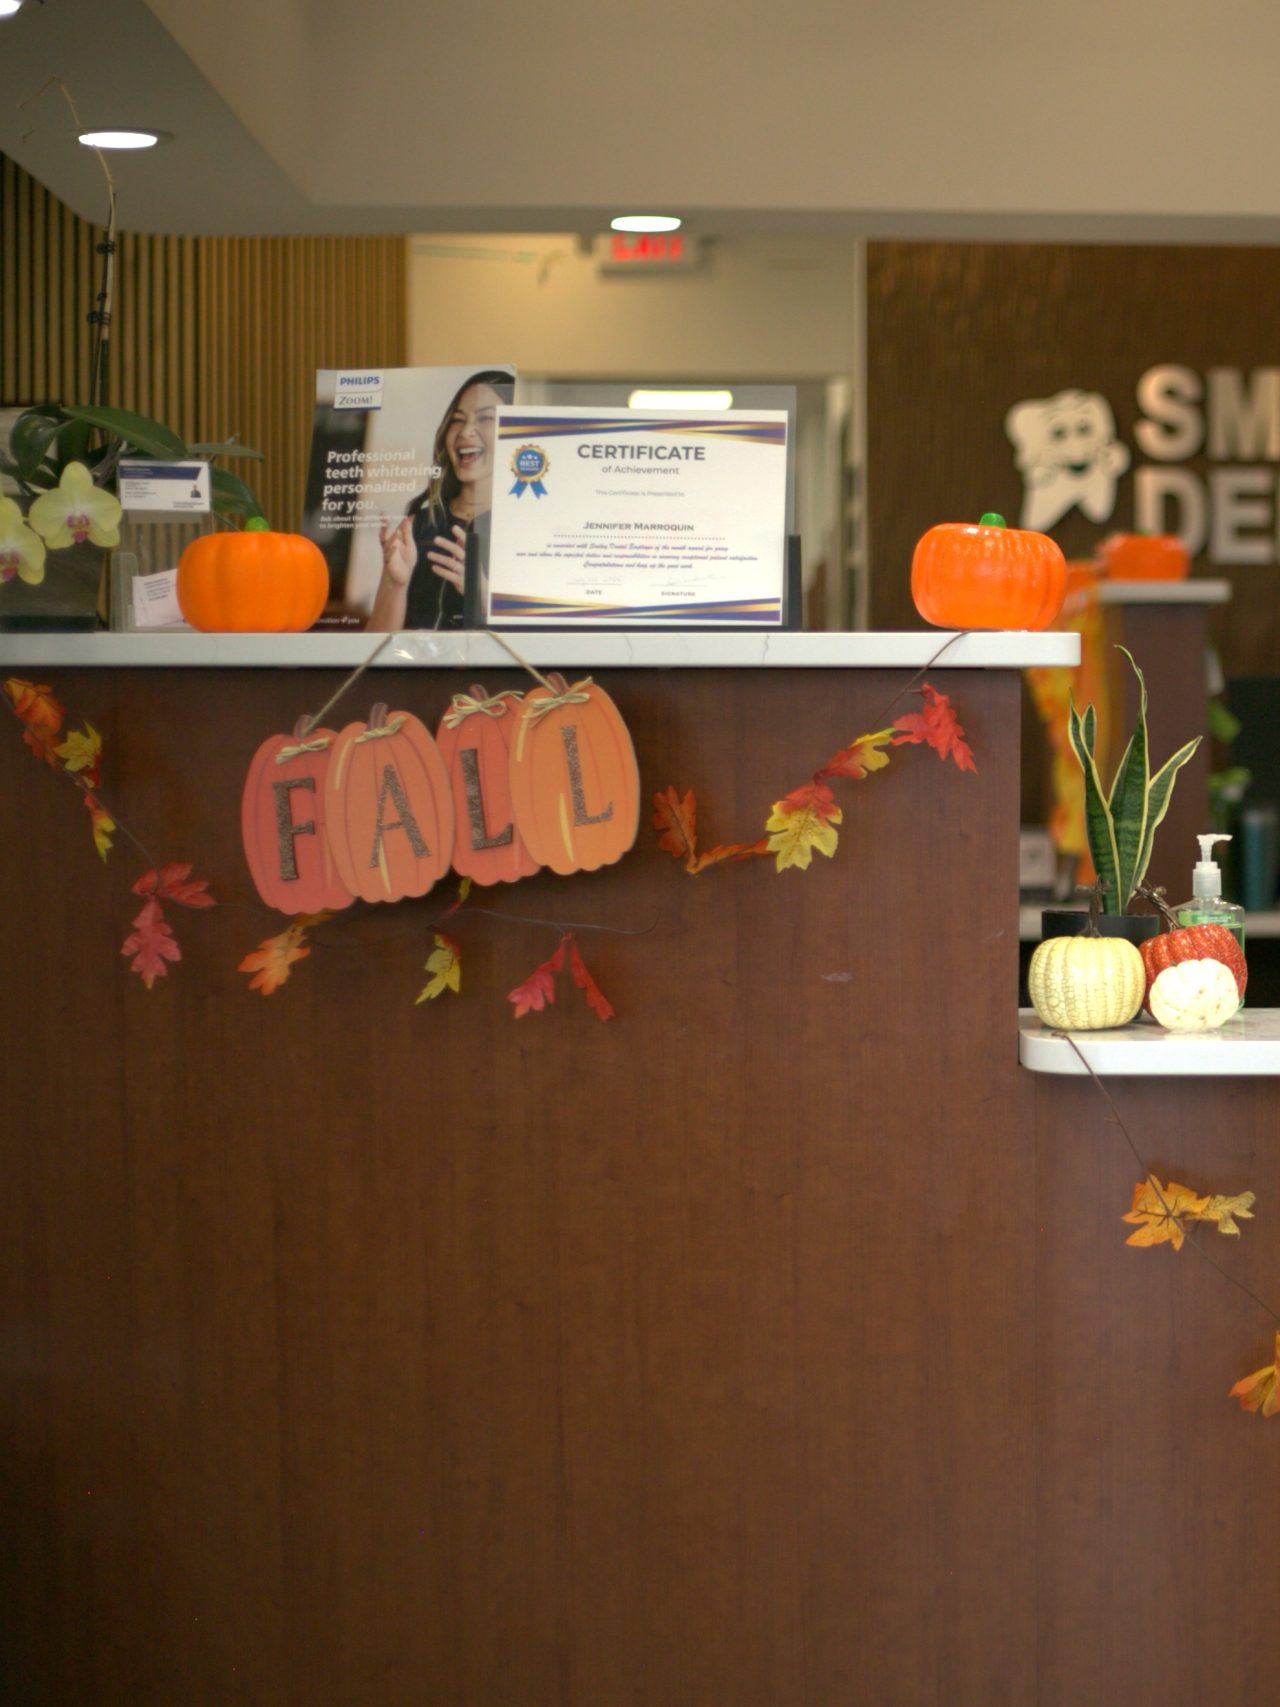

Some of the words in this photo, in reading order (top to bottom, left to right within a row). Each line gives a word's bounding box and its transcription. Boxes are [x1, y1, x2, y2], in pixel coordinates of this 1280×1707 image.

[340, 376, 380, 386] PHILIPS
[327, 449, 416, 463] Professional
[577, 444, 706, 461] CERTIFICATE
[519, 460, 540, 468] BEST
[602, 465, 612, 474] of
[614, 465, 680, 475] Achievement
[325, 465, 364, 479] teeth
[367, 463, 443, 480] whitening
[323, 480, 416, 497] personalized
[321, 498, 344, 511] for
[583, 522, 632, 530] JENNIFER
[634, 523, 695, 532] MARROQUIN
[272, 725, 613, 881] FALL
